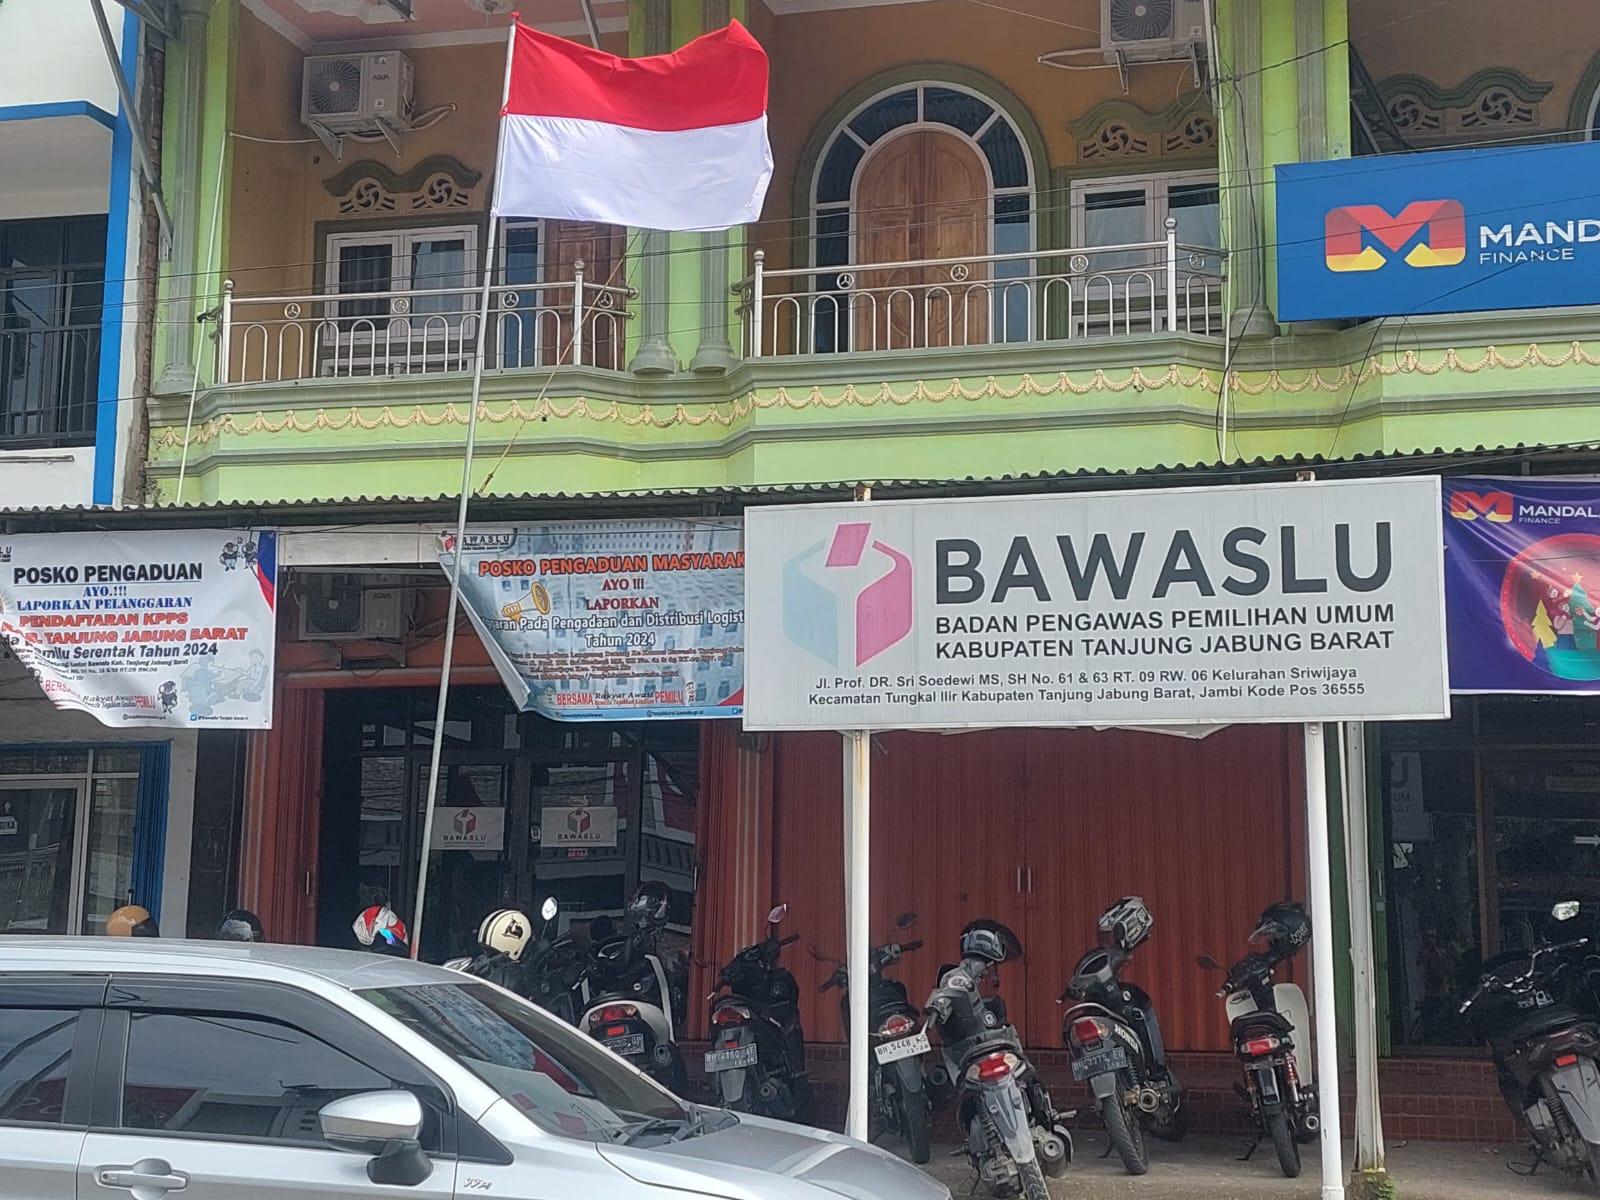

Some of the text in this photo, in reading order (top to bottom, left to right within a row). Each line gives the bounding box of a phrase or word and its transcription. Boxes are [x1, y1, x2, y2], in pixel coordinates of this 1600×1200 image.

[1479, 247, 1575, 264] FINANCE
[1519, 505, 1600, 519] MANDAL
[1519, 517, 1560, 525] FINANCE
[479, 560, 537, 577] POSKO
[540, 555, 648, 576] PENGADUAN
[935, 521, 1393, 604] BAWASLU
[13, 562, 202, 584] POSKO PENGADUAN
[602, 579, 630, 591] AYO
[17, 597, 192, 611] LAPORKAN PELANGGARAN
[585, 597, 659, 611] LAPORKAN
[19, 612, 188, 628] PENDAFTARAN KPPS
[520, 615, 549, 631] Pada
[552, 613, 618, 632] Pengadaan
[620, 612, 643, 628] dan
[646, 610, 704, 627] Distribusi
[936, 603, 1394, 634] BADAN PENGAWAS PEMILIHAN UMUM
[45, 631, 118, 644] TANJUNG
[122, 629, 187, 643] JABUNG
[190, 627, 248, 640] BARAT
[584, 631, 656, 648] Tahun 2024
[73, 645, 135, 659] Serentak
[140, 644, 180, 658] Tahun
[183, 642, 218, 656] 2024
[936, 630, 1394, 659] KABUPATEN TANJUNG JABUNG BARAT
[815, 667, 1357, 689] Jl. Prof. DR. Sri Soedewi MS, SH No. 61 & 63 RT. 09 RW. 06 Kelurahan Sriwijaya
[556, 693, 594, 706] BERSAMA
[595, 691, 626, 700] Rakyat
[808, 683, 1365, 705] Kecamatan Tungkal Ilir Kabupaten Tanjung Jabung Barat, Jambi Kode Pos 36555
[443, 834, 487, 842] BAWASLU
[557, 833, 601, 841] BAWASLU
[1113, 1023, 1139, 1054] HONDA
